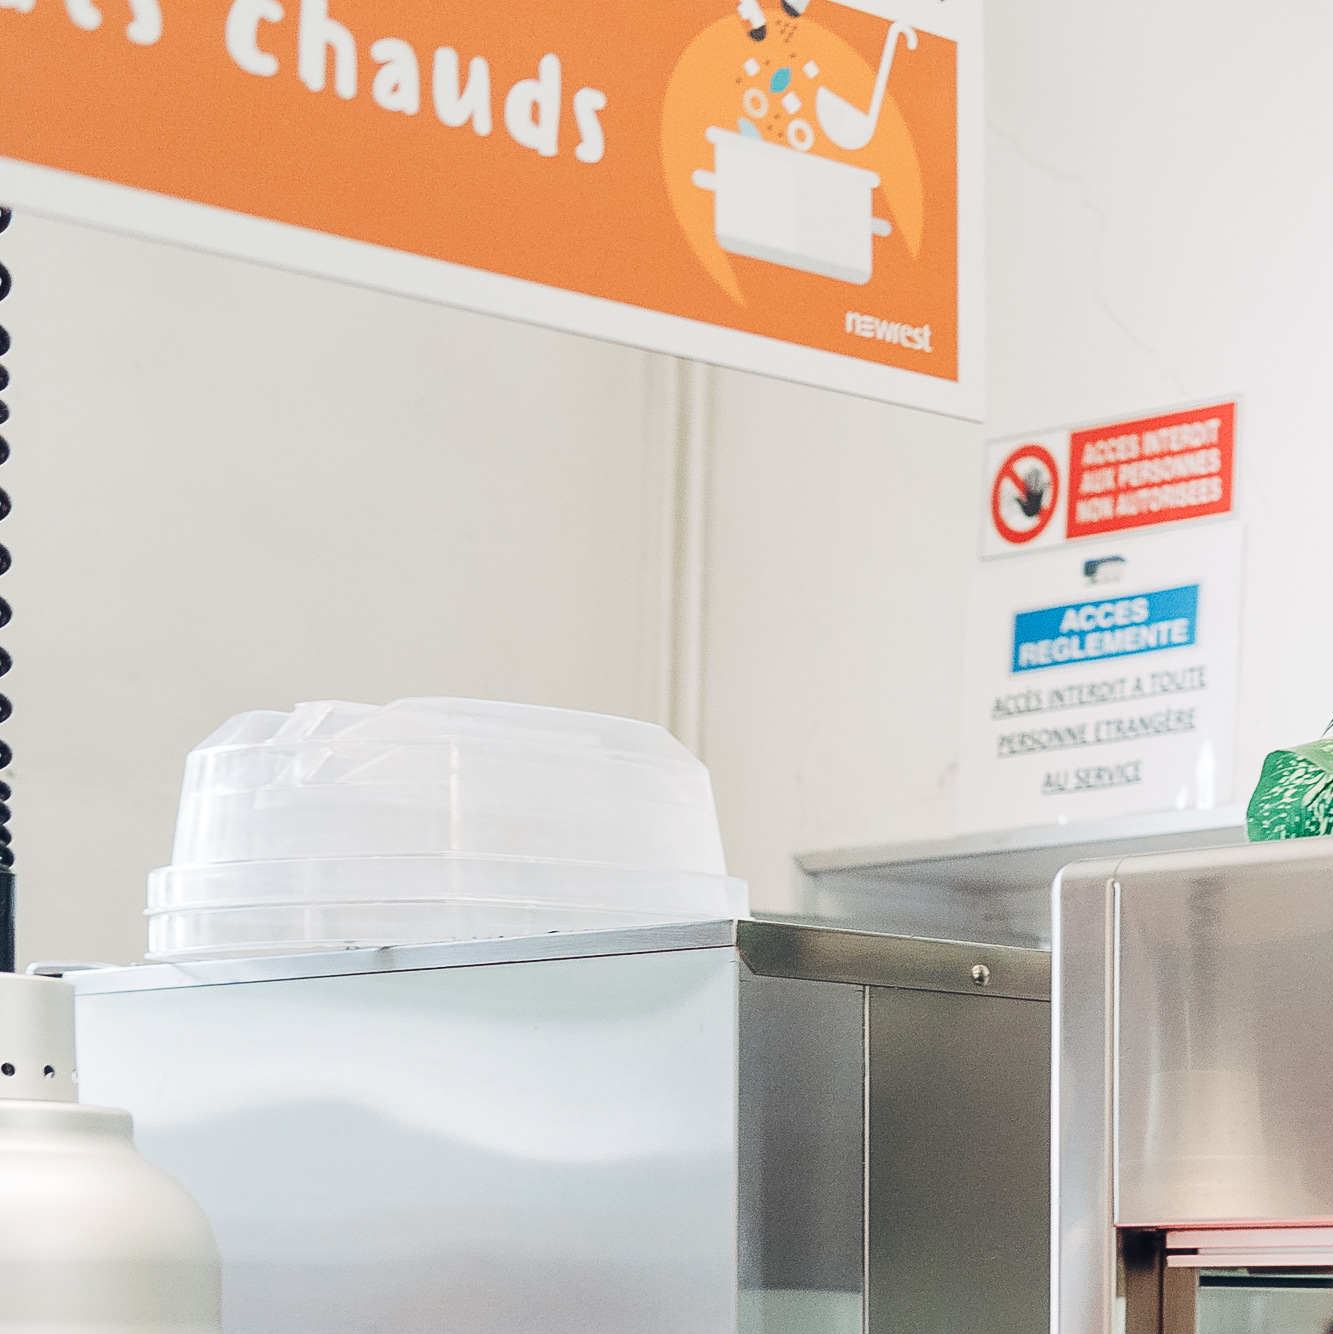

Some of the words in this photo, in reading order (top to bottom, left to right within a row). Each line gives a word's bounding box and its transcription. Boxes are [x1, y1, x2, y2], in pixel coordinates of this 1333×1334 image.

[844, 310, 933, 353] newrest
[1141, 417, 1221, 456] INTERDIT
[1117, 447, 1221, 488] PERSONNES
[1058, 596, 1150, 634] ACCES
[1017, 616, 1191, 668] REGLEMENTE
[1050, 677, 1126, 706] INTERDIT
[997, 722, 1087, 756] PERSONNE
[1074, 759, 1142, 789] SERVICE
